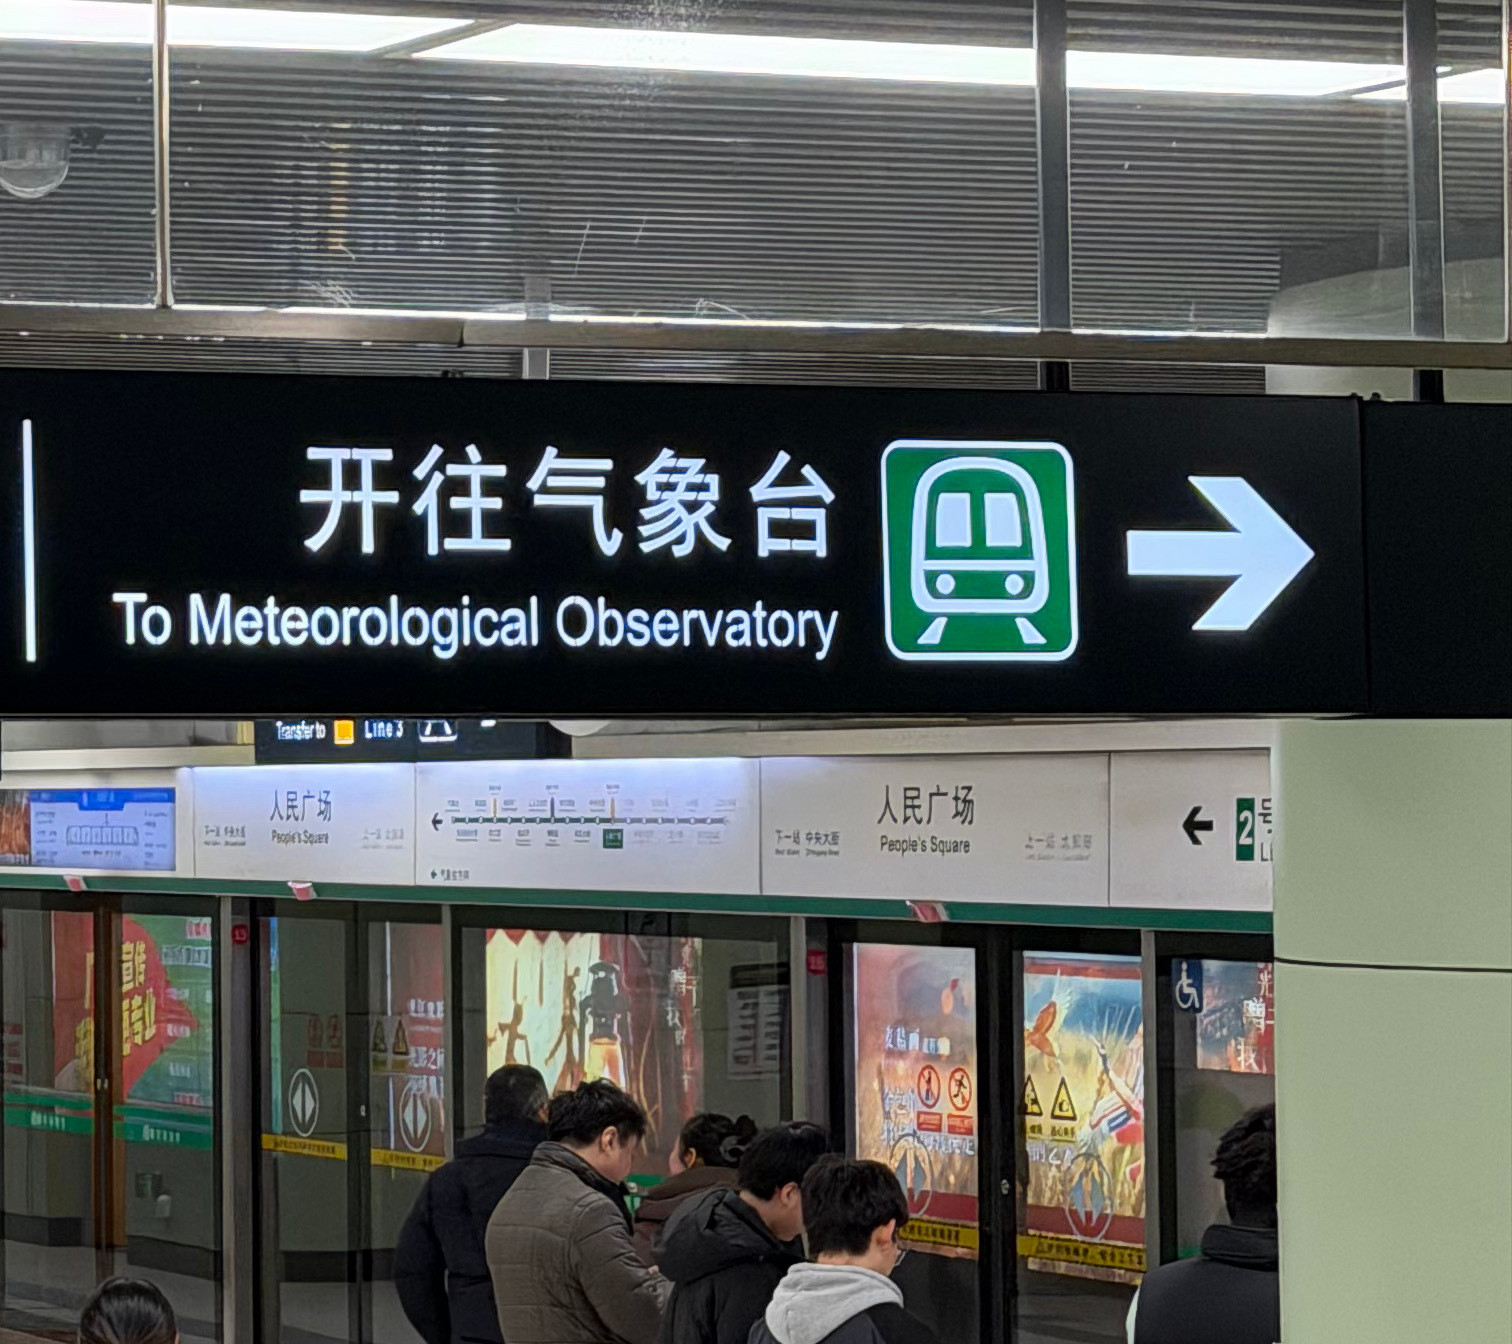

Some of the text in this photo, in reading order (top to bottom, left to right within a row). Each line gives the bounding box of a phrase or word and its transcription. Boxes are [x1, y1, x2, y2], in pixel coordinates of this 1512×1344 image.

[300, 444, 835, 557] 开往气象台
[113, 593, 838, 660] To Meteorological Observatory
[275, 720, 326, 740] Transfer to
[364, 720, 404, 739] Line 3
[270, 789, 332, 822] 人民广场
[877, 784, 975, 826] 人民广场
[271, 829, 329, 845] People's Square
[1238, 810, 1254, 846] 2
[880, 834, 971, 856] People's Square
